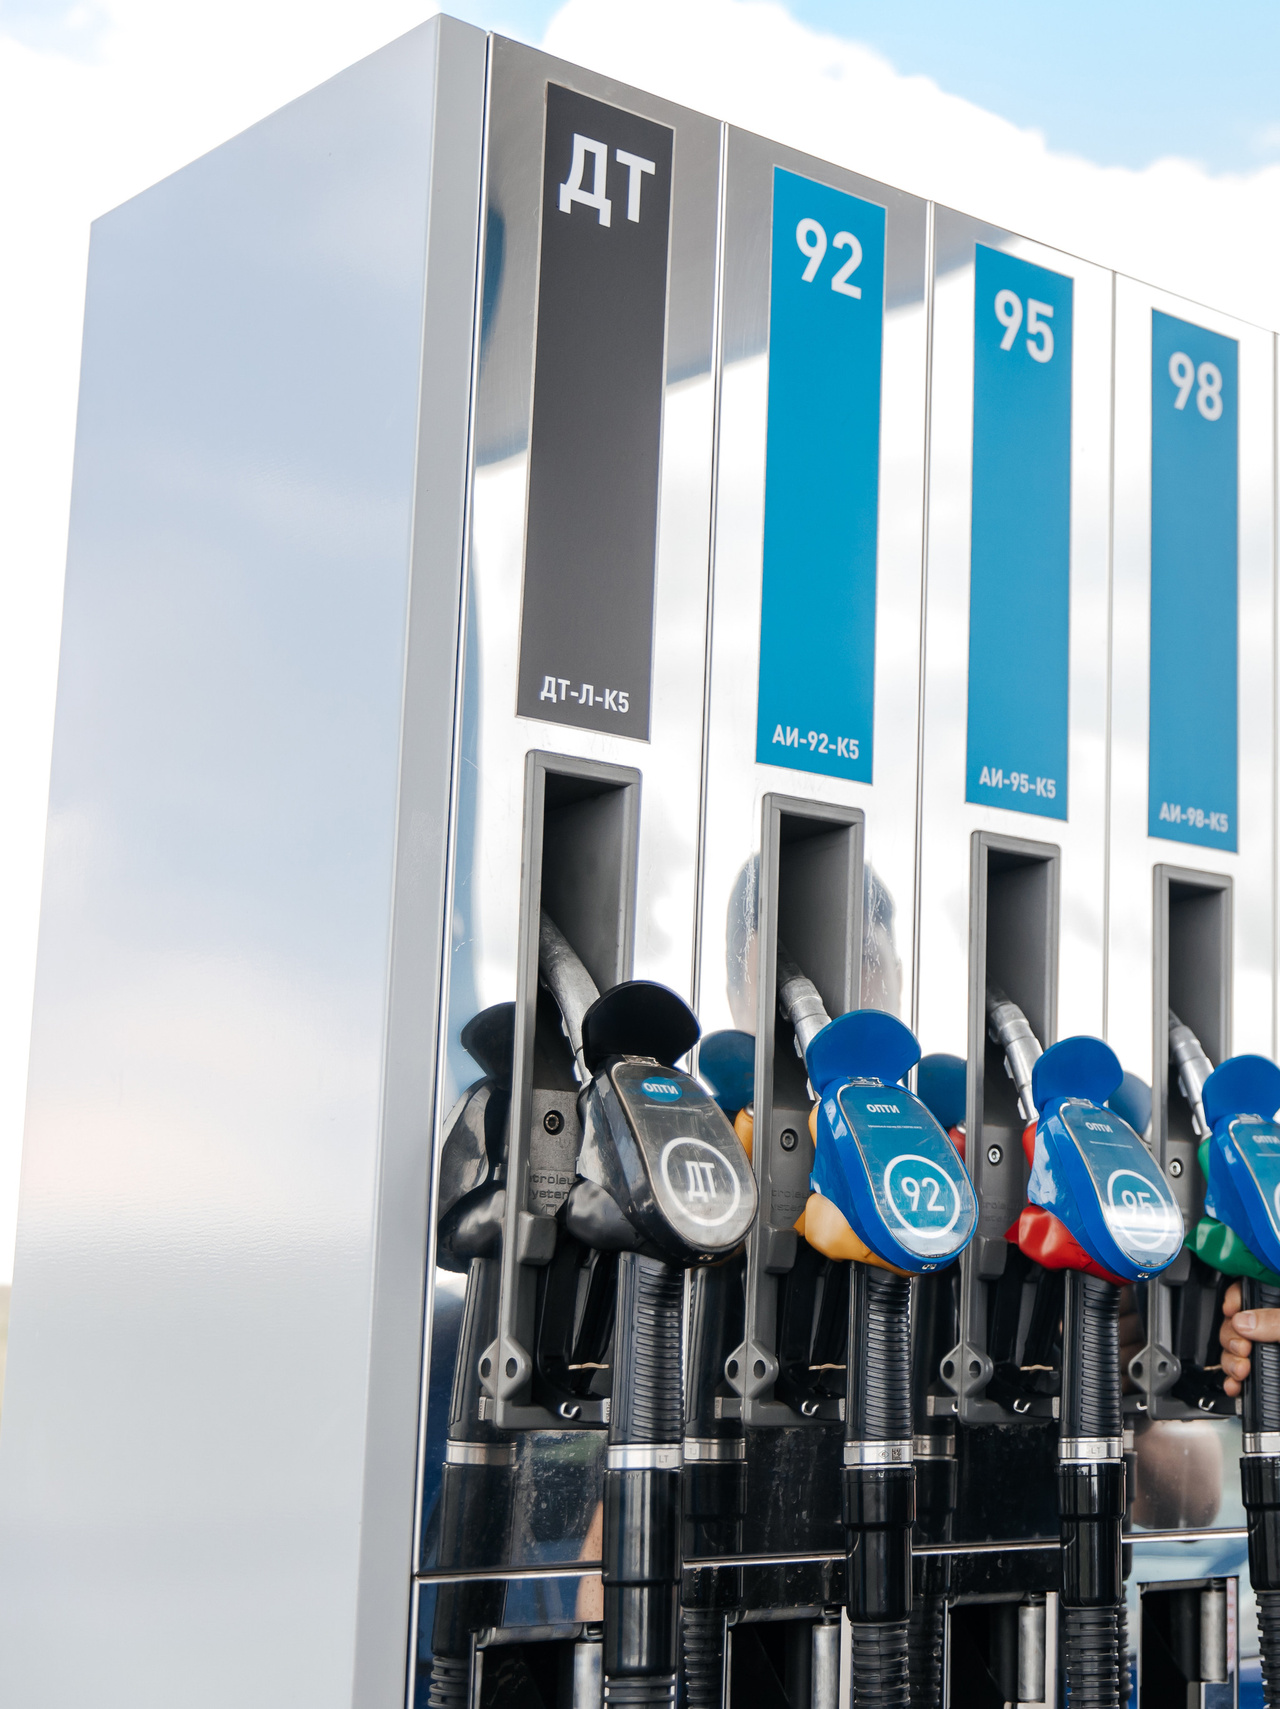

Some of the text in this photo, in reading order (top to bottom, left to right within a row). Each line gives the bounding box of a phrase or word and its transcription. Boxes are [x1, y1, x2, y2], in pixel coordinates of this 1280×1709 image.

[558, 132, 656, 228] ДТ
[795, 217, 863, 300] 92
[994, 289, 1054, 363] 95
[1168, 351, 1223, 422] 98
[540, 675, 630, 714] ДТ-Л-К5
[772, 724, 860, 760] АИ-92-К5
[979, 766, 1056, 799] АИ-95-К5
[1159, 802, 1229, 833] АИ-98-К5
[643, 1082, 679, 1095] ОПТИ
[866, 1103, 901, 1114] ОПТИ
[1085, 1122, 1114, 1134] ОПТИ
[1252, 1134, 1280, 1145] ОПТИ
[684, 1160, 718, 1203] ДТ
[901, 1176, 945, 1212] 92
